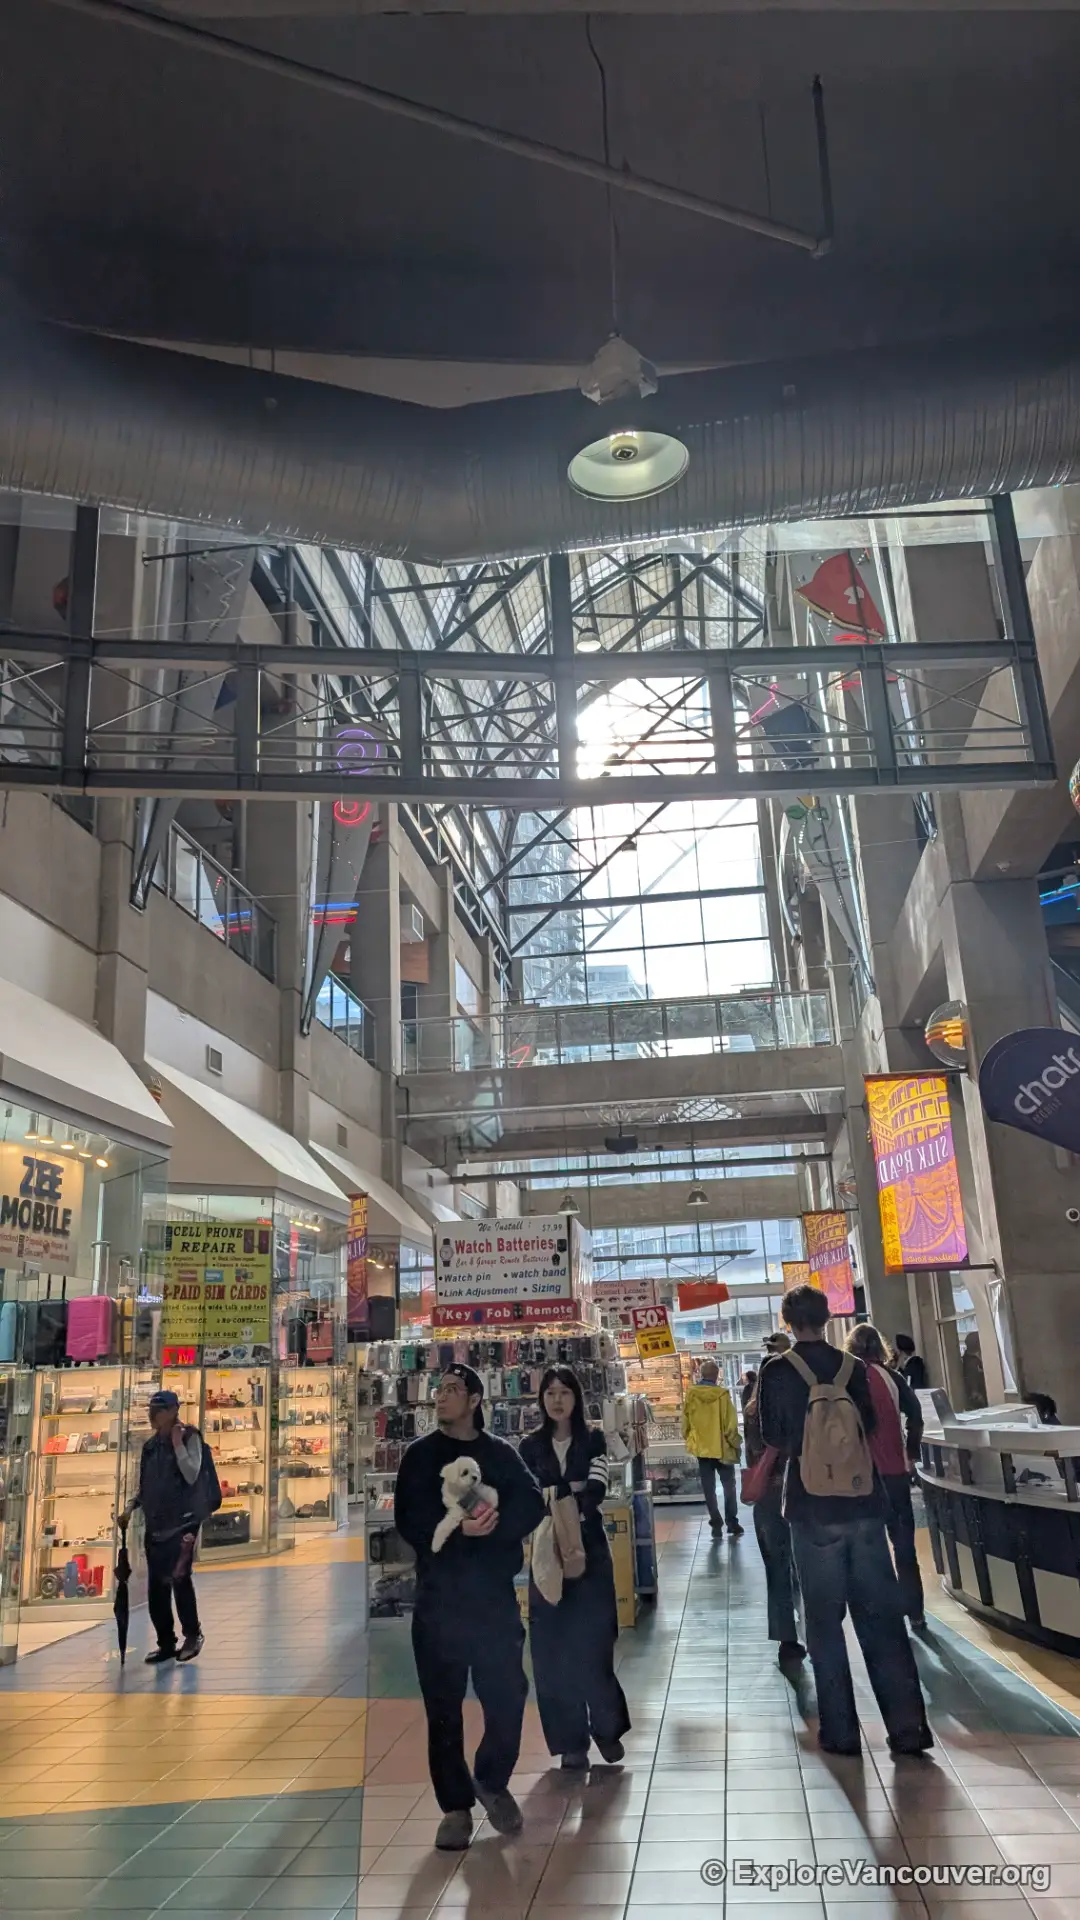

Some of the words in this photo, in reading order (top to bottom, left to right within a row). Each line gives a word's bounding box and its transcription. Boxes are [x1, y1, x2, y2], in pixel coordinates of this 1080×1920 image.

[20, 1156, 64, 1200] ZEE
[0, 1195, 72, 1237] MOBILE
[174, 1226, 202, 1237] CELL
[207, 1227, 244, 1238] PHONE
[478, 1223, 491, 1232] We
[495, 1221, 523, 1232] Install
[542, 1224, 563, 1232] $7.99
[180, 1241, 236, 1253] REPAIR
[455, 1238, 492, 1255] Watch
[497, 1236, 554, 1252] Batteries
[444, 1272, 472, 1283] Watch
[476, 1272, 491, 1281] pin
[511, 1268, 539, 1279] watch
[542, 1267, 567, 1277] band
[205, 1284, 226, 1300] SIM
[230, 1285, 268, 1300] CARDS
[444, 1289, 463, 1298] Link
[465, 1286, 518, 1298] Adjustment
[531, 1284, 561, 1294] Sizing
[446, 1310, 471, 1320] Key
[487, 1307, 511, 1318] Fob
[526, 1304, 573, 1316] Remote
